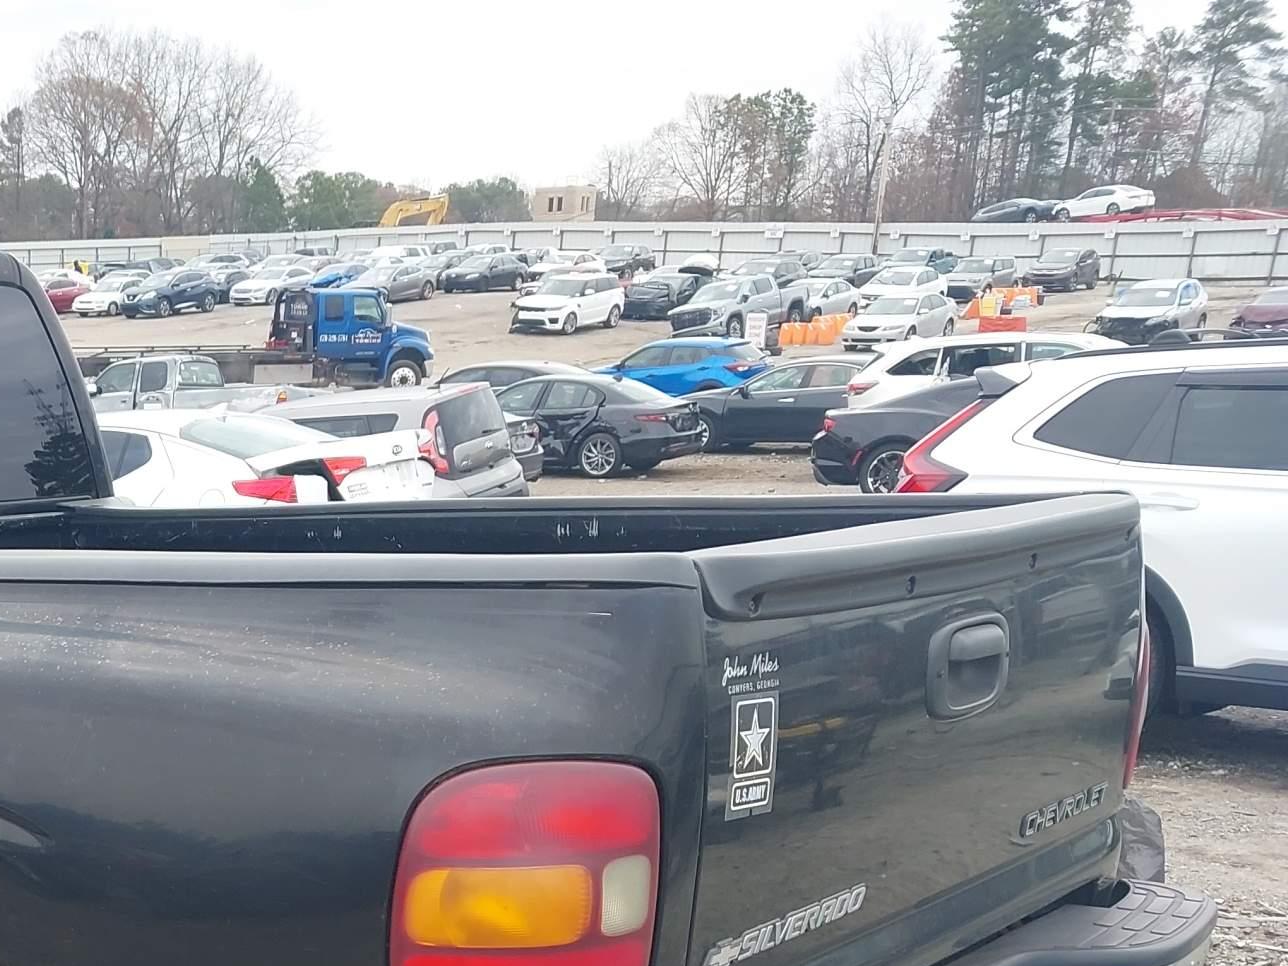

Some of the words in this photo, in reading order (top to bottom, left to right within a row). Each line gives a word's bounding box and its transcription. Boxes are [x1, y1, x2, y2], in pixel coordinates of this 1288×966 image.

[722, 655, 748, 686] John
[749, 651, 780, 678] Miles
[1024, 782, 1109, 837] CHEVROLET
[737, 883, 868, 961] SILVERADO
